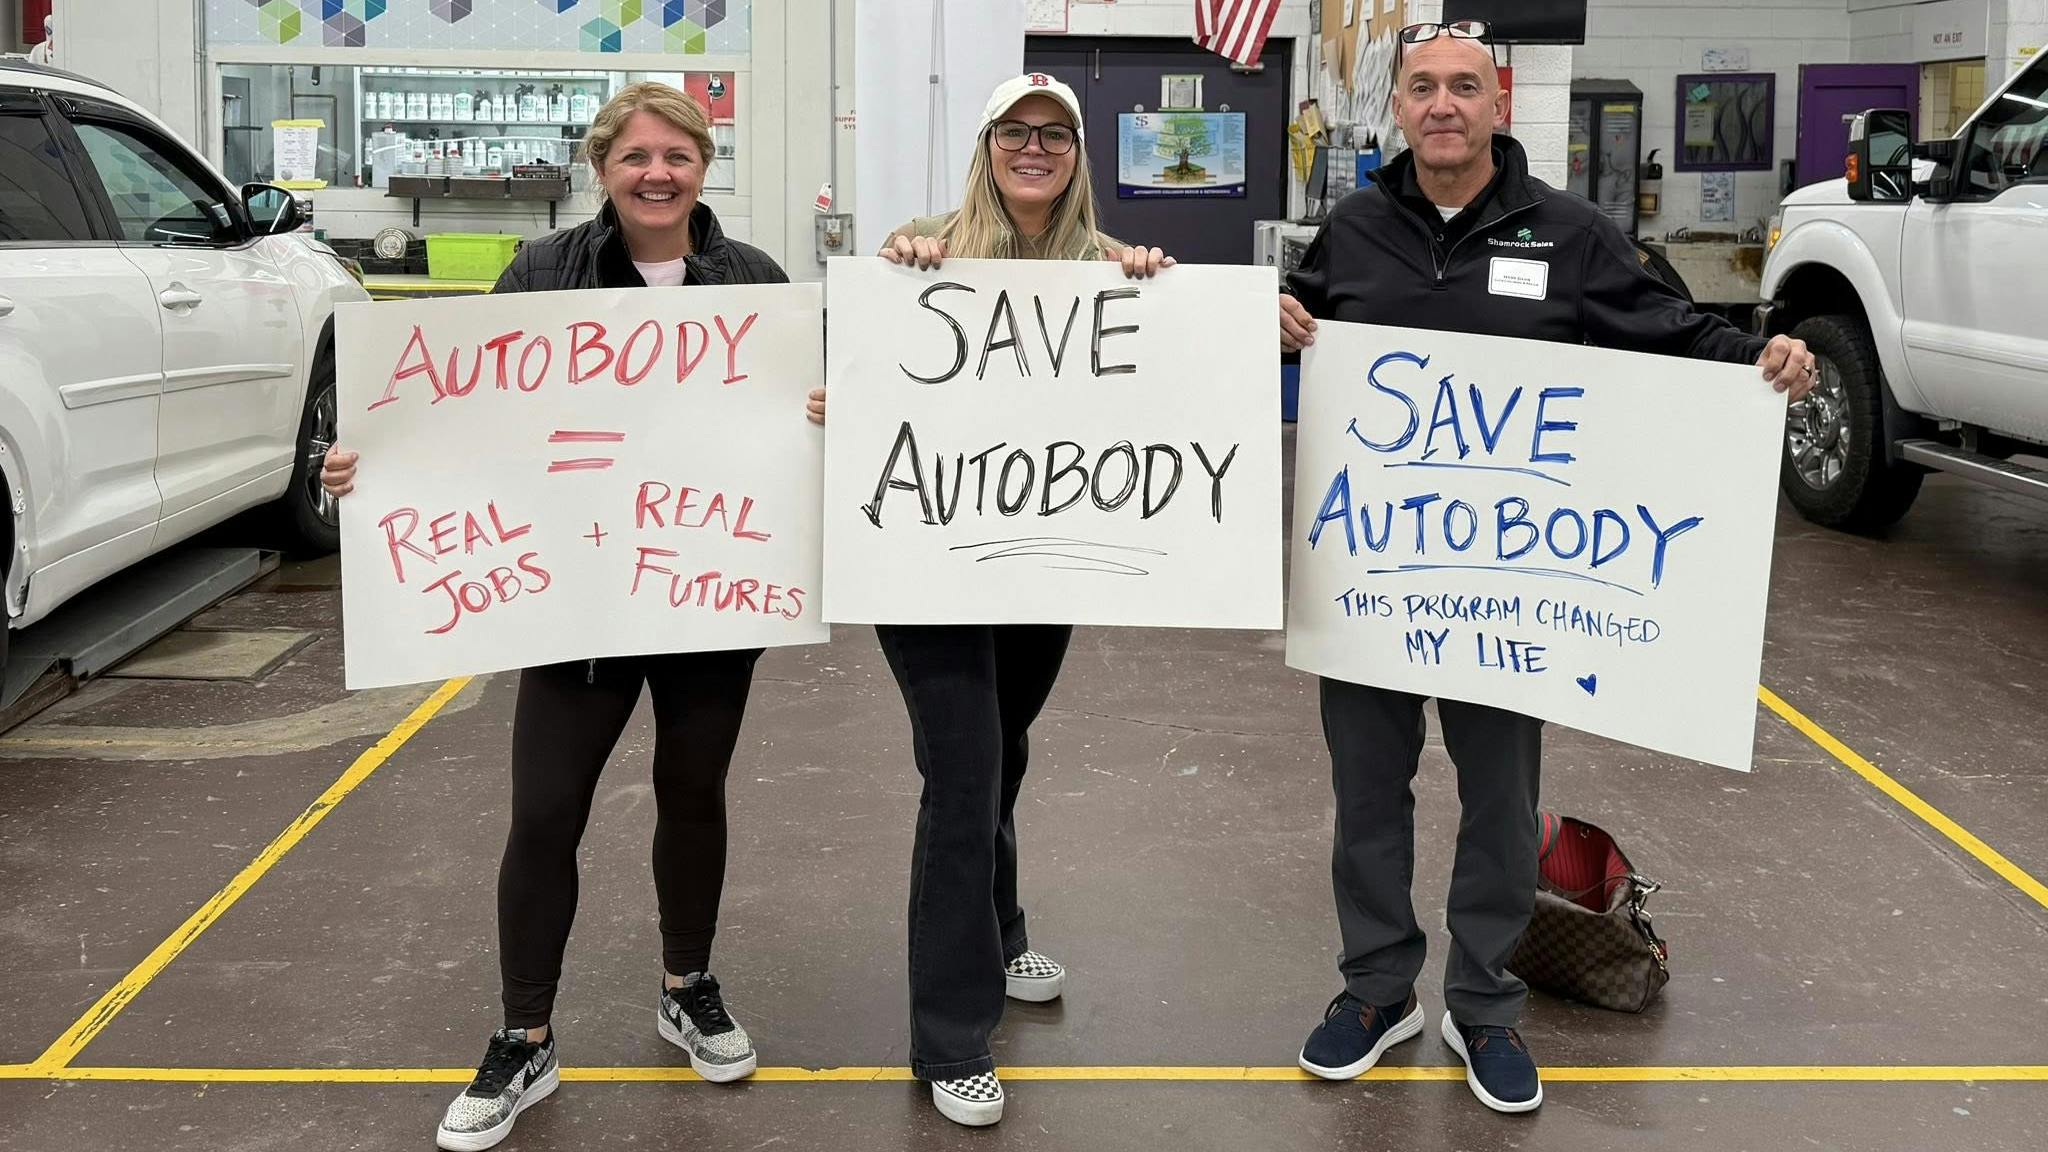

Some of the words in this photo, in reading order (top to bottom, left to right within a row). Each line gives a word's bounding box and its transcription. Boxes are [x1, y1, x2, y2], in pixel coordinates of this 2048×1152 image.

[1027, 74, 1049, 87] B
[367, 312, 759, 411] AUTOBODY
[899, 281, 1142, 385] SAVE
[1345, 352, 1584, 464] SAVE
[634, 481, 772, 542] REAL
[861, 421, 1240, 529] AUTOBODY
[378, 498, 533, 584] REAL
[1307, 464, 1704, 589] AUTOBODY
[421, 551, 552, 635] JOBS
[629, 546, 808, 621] FUTURES
[1335, 587, 1394, 619] THIS
[1402, 594, 1521, 625] PROGRAM
[1536, 599, 1661, 646] CHANGED
[1405, 628, 1450, 666] MY
[1477, 632, 1548, 673] LIFE
